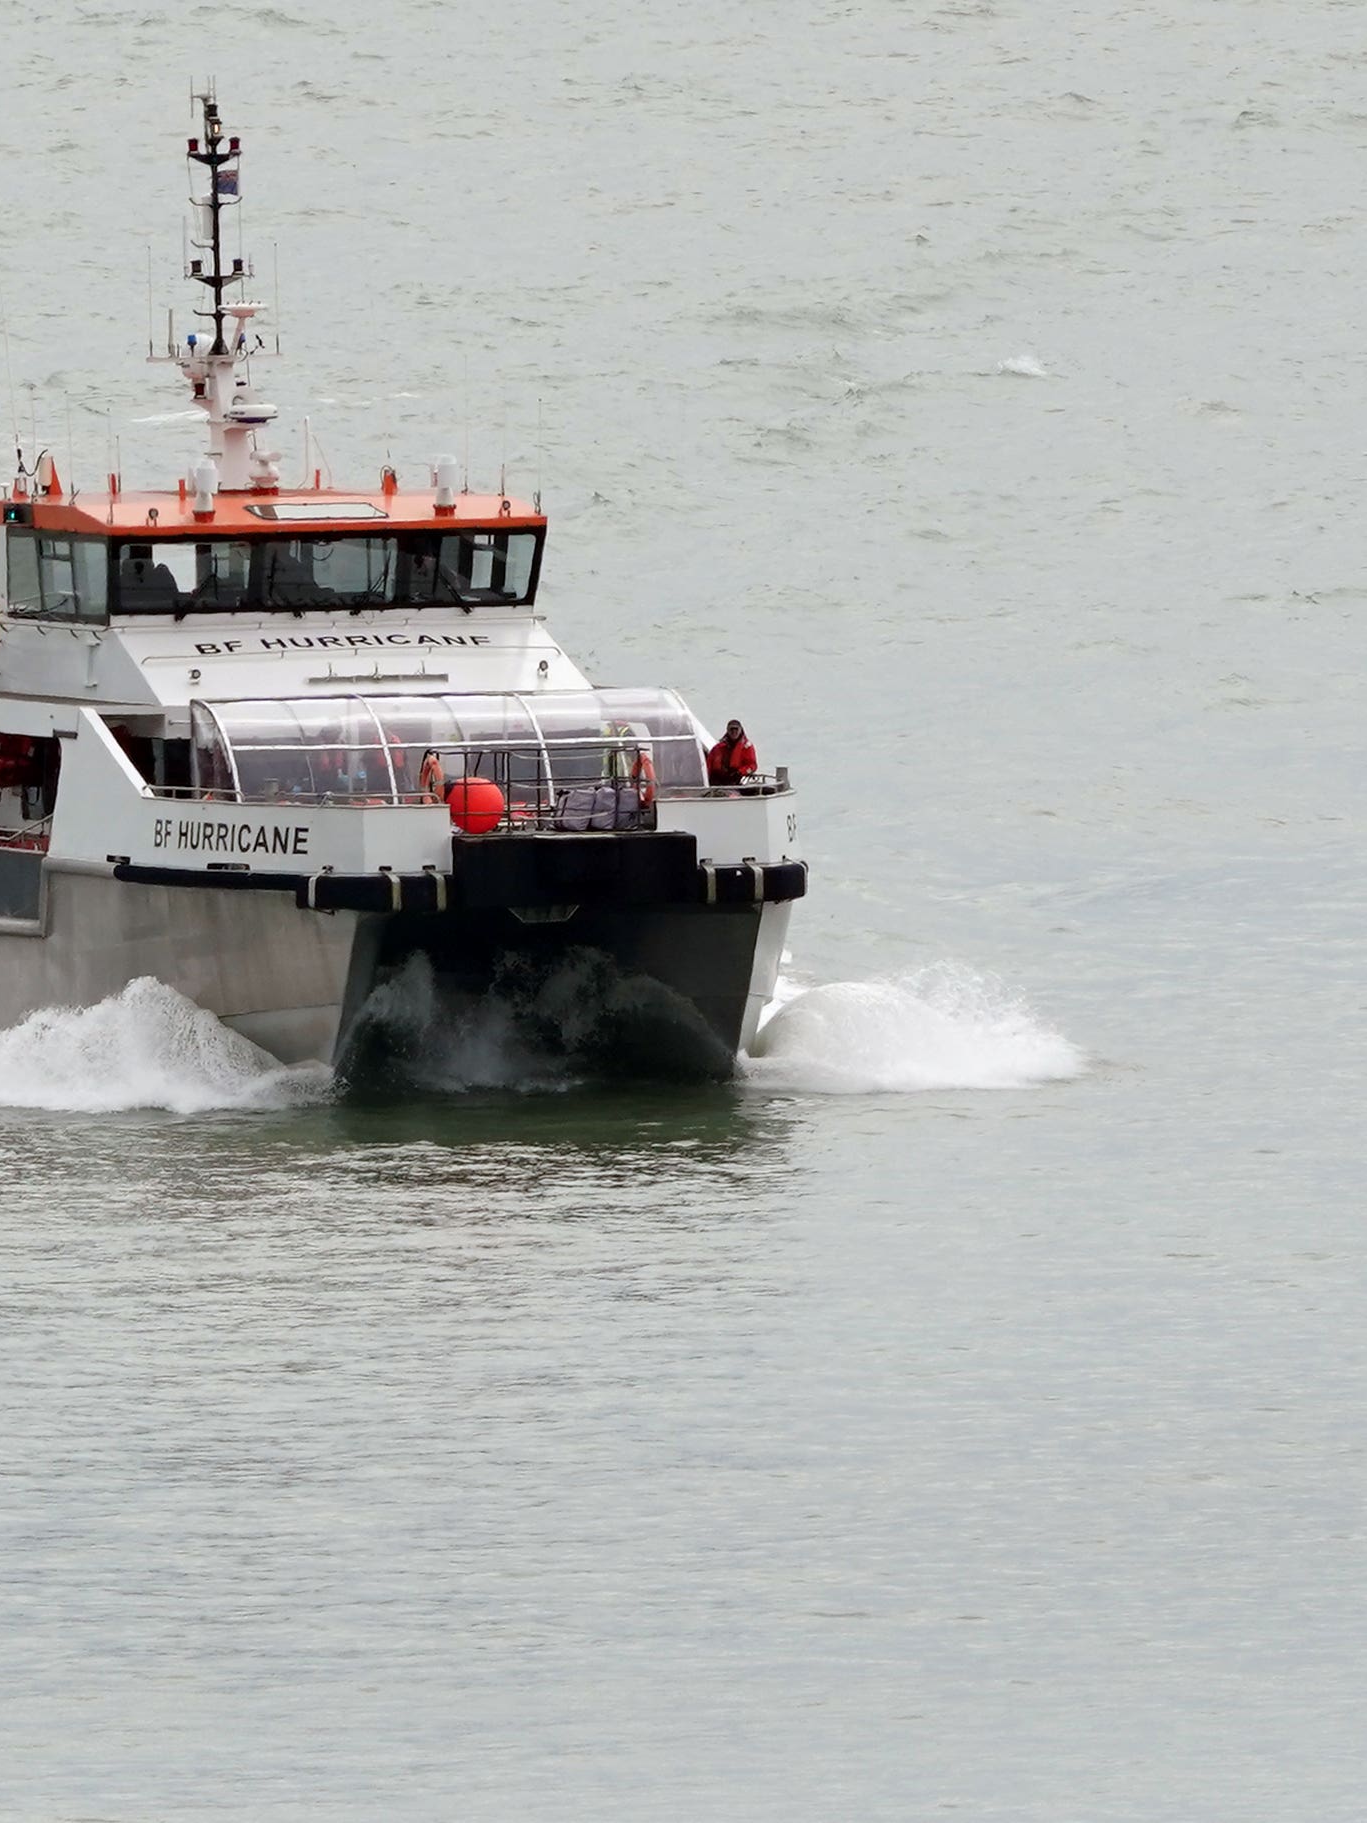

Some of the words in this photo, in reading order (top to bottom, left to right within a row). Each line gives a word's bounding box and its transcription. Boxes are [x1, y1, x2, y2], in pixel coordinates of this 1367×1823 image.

[195, 640, 243, 655] BF
[154, 819, 172, 848] BF
[178, 820, 309, 855] HURRICANE
